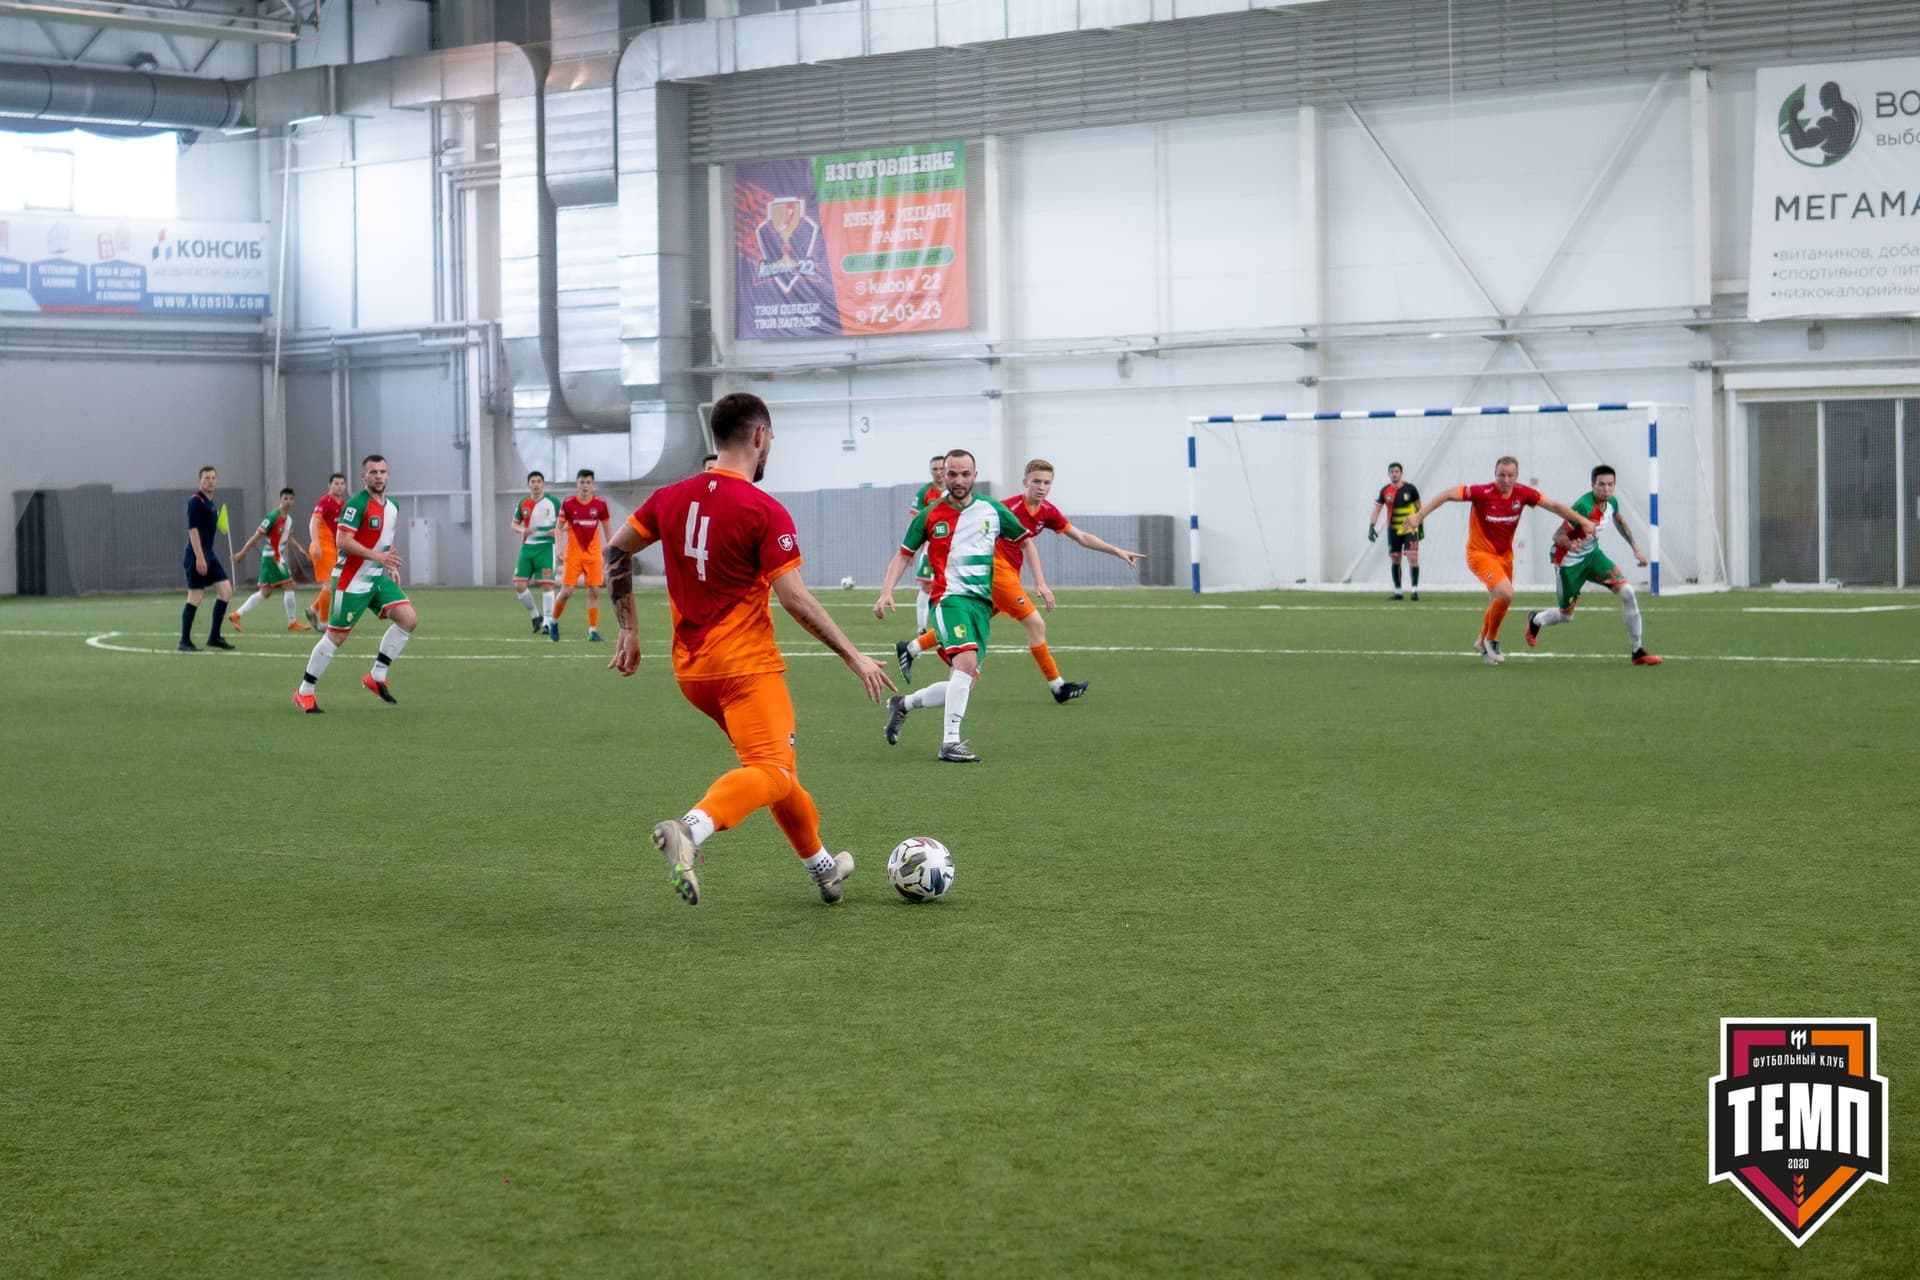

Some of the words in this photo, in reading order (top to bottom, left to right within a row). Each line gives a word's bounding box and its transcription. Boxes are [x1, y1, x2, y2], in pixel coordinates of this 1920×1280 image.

[824, 150, 955, 183] ИЗГОТОВЛЕНИЕ
[897, 202, 953, 224] МЕДАЛИ
[177, 240, 262, 259] КОНСИБ
[1779, 265, 1888, 281] спортивного
[869, 301, 941, 324] 72-03-23
[860, 416, 869, 433] 3
[684, 501, 710, 581] 4
